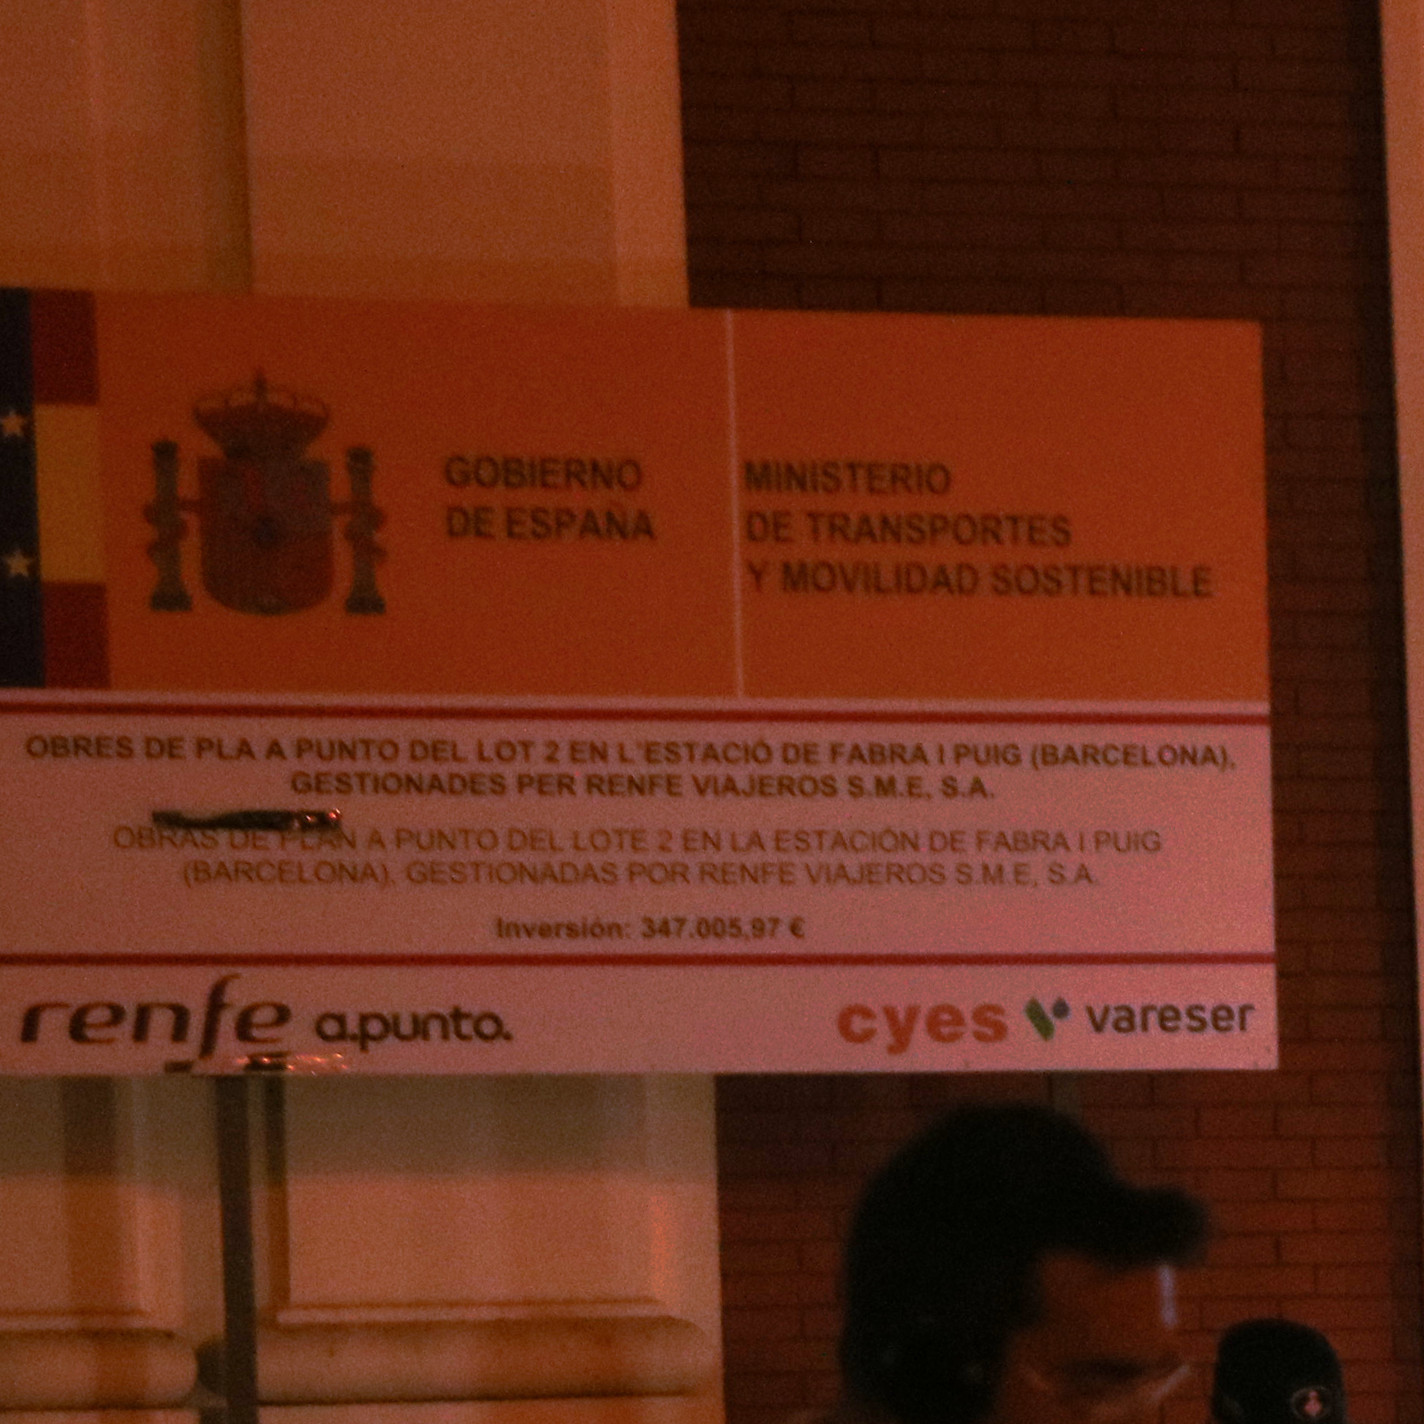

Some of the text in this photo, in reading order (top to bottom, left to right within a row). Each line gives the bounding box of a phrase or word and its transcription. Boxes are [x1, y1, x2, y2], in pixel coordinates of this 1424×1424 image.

[444, 456, 641, 489] GOBIERNO
[745, 461, 952, 494] MINISTERIO
[447, 506, 496, 539] DE
[745, 511, 1072, 546] DE TRANSPORTES
[746, 562, 1213, 598] Y MOVILIDAD SOSTENIBLE
[26, 736, 133, 759] OBRES
[145, 737, 186, 760] DE
[197, 738, 256, 761] PLA
[265, 739, 287, 762] A
[297, 739, 399, 763] PUNTO
[409, 740, 469, 763] DEL
[478, 741, 535, 763] LOT
[544, 741, 560, 763] 2
[570, 741, 608, 764] EN
[782, 742, 821, 765] DE
[830, 742, 927, 765] FABRA
[937, 743, 944, 765] I
[954, 743, 1022, 766] PUIG
[291, 773, 507, 796] GESTIONADES
[517, 773, 577, 796] PER
[585, 773, 685, 797] RENFE
[694, 774, 837, 797] VIAJEROS
[114, 824, 1162, 854] OBRAS DE PLAN A PUNTO DEL LOTE 2 EN LA ESTACIÓN DE FABRA I PUIG
[407, 862, 619, 887] GESTIONADAS
[629, 862, 687, 886] POR
[700, 862, 797, 886] RENFE
[806, 862, 946, 887] VIAJEROS
[495, 917, 805, 944] Inversión: 347.005,97 €
[20, 972, 291, 1059] renfe
[837, 1001, 1010, 1055] cyes
[1085, 1001, 1255, 1034] vareser
